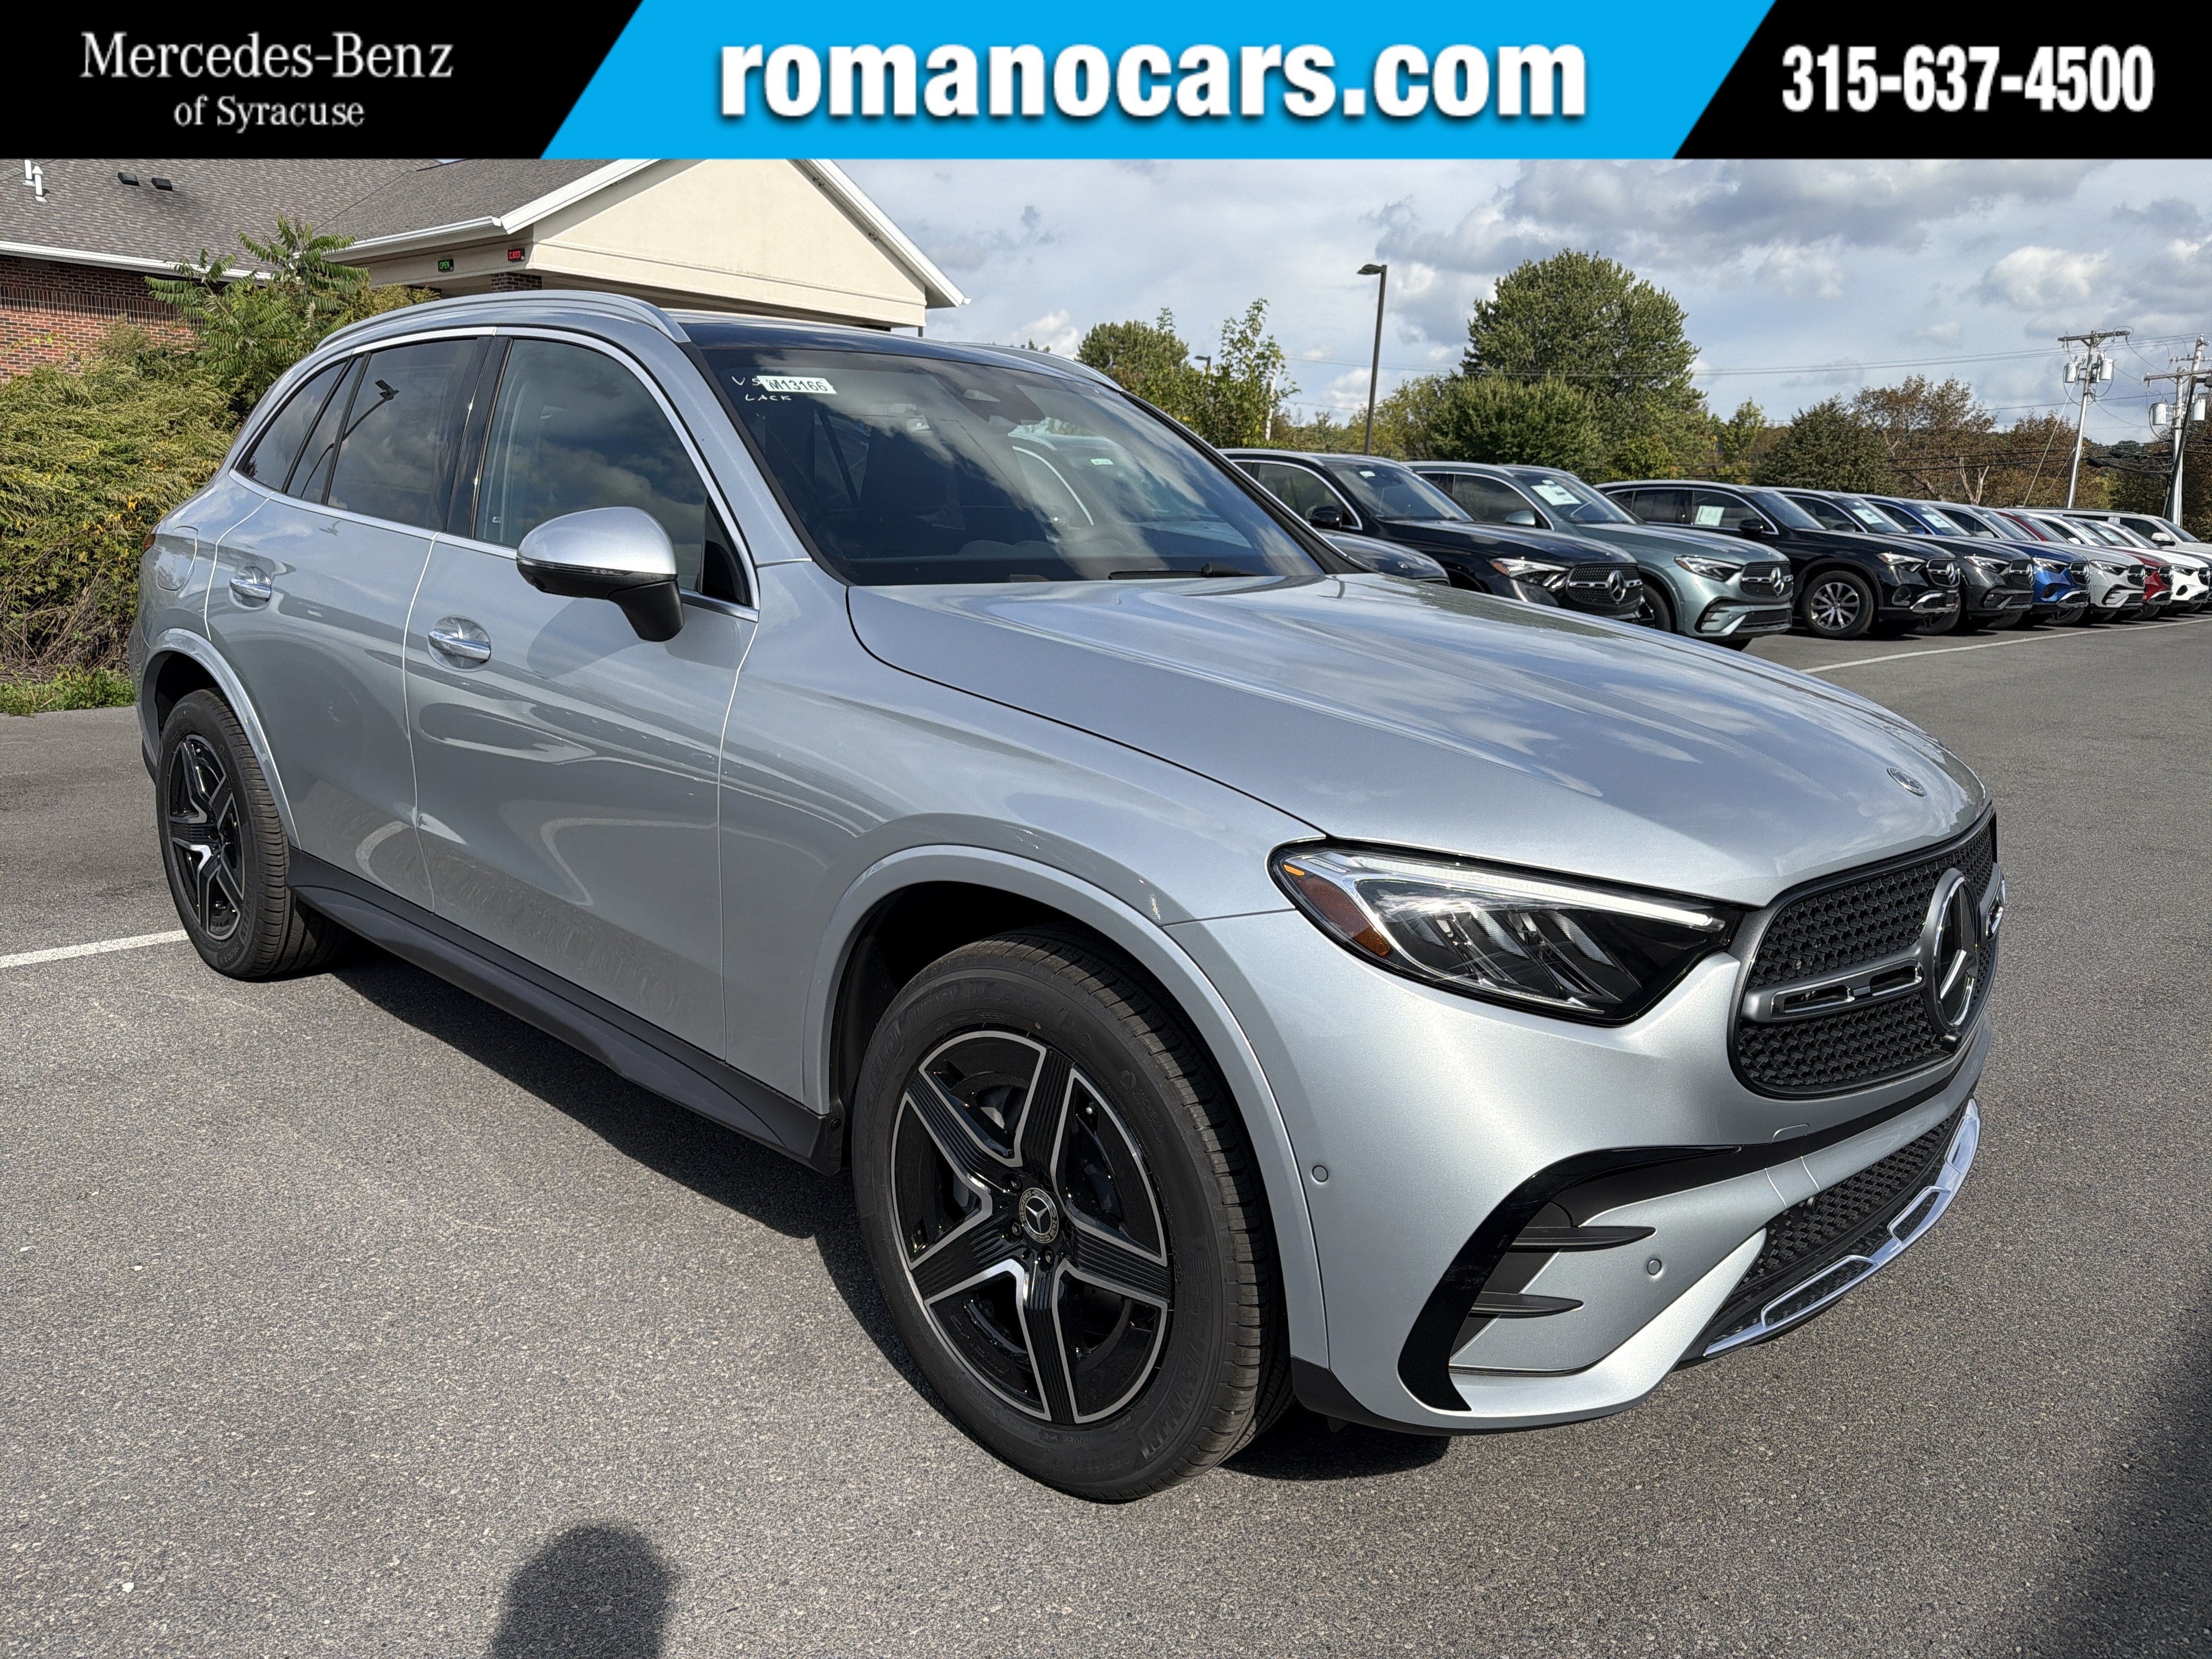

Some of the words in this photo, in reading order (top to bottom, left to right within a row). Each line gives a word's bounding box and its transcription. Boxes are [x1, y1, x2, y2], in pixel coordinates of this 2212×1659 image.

[765, 379, 828, 392] M13166
[745, 393, 792, 402] LACK
[1049, 1218, 1057, 1237] BENZ
